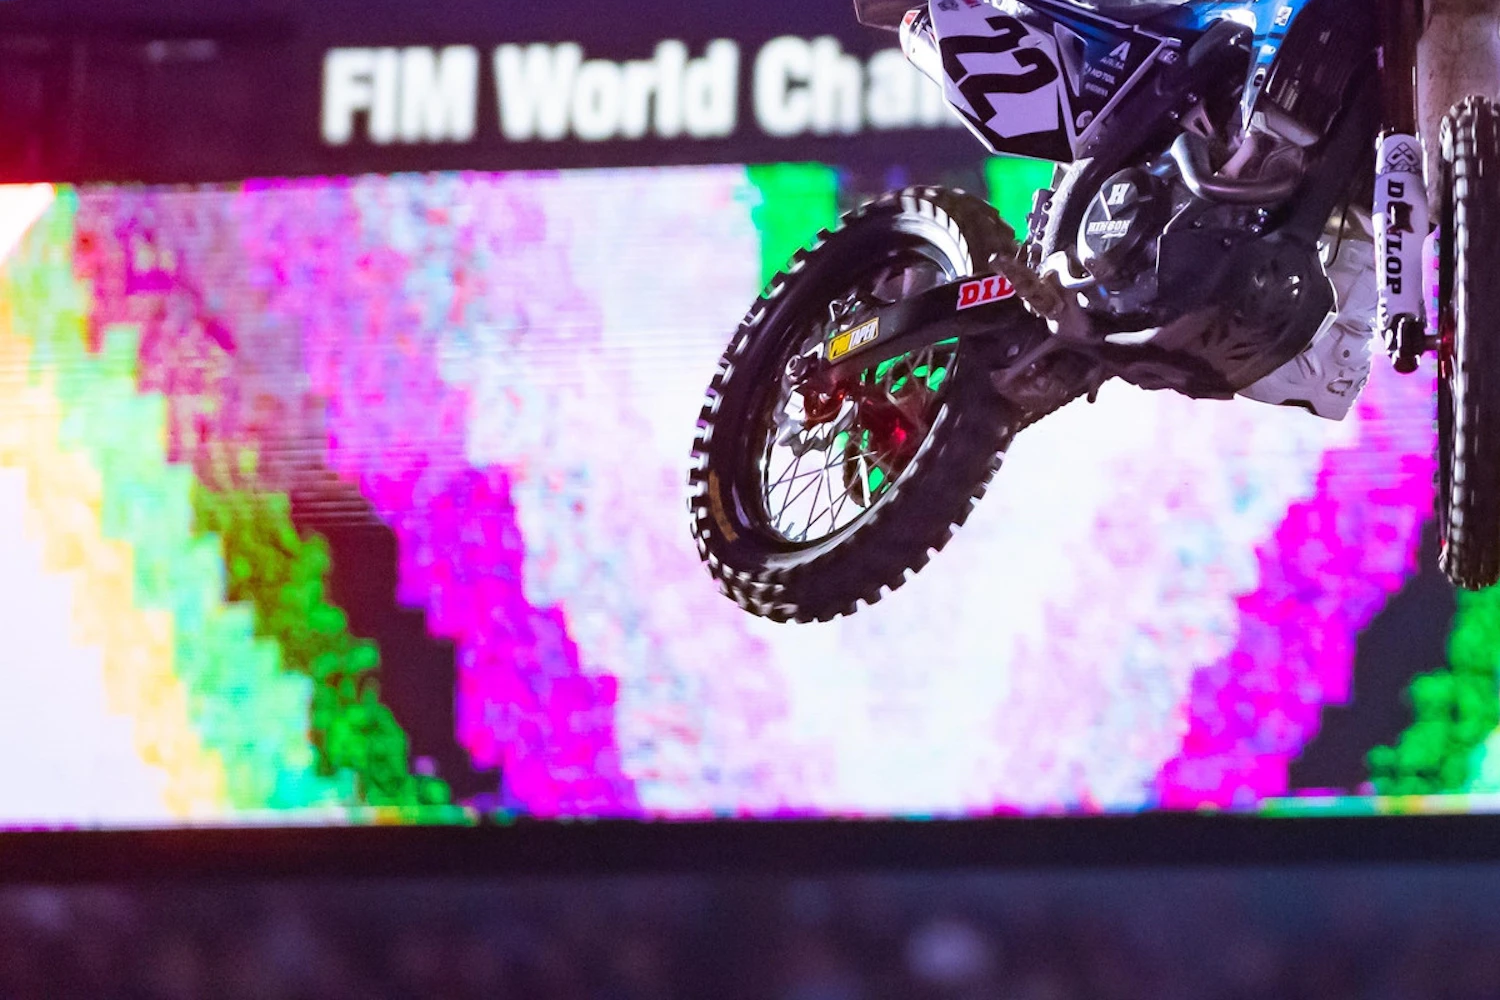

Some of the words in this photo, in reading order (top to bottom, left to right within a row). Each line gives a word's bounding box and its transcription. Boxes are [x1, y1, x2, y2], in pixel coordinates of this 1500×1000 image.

[323, 45, 478, 145] FIM
[494, 39, 740, 142] World
[939, 15, 1059, 122] 22
